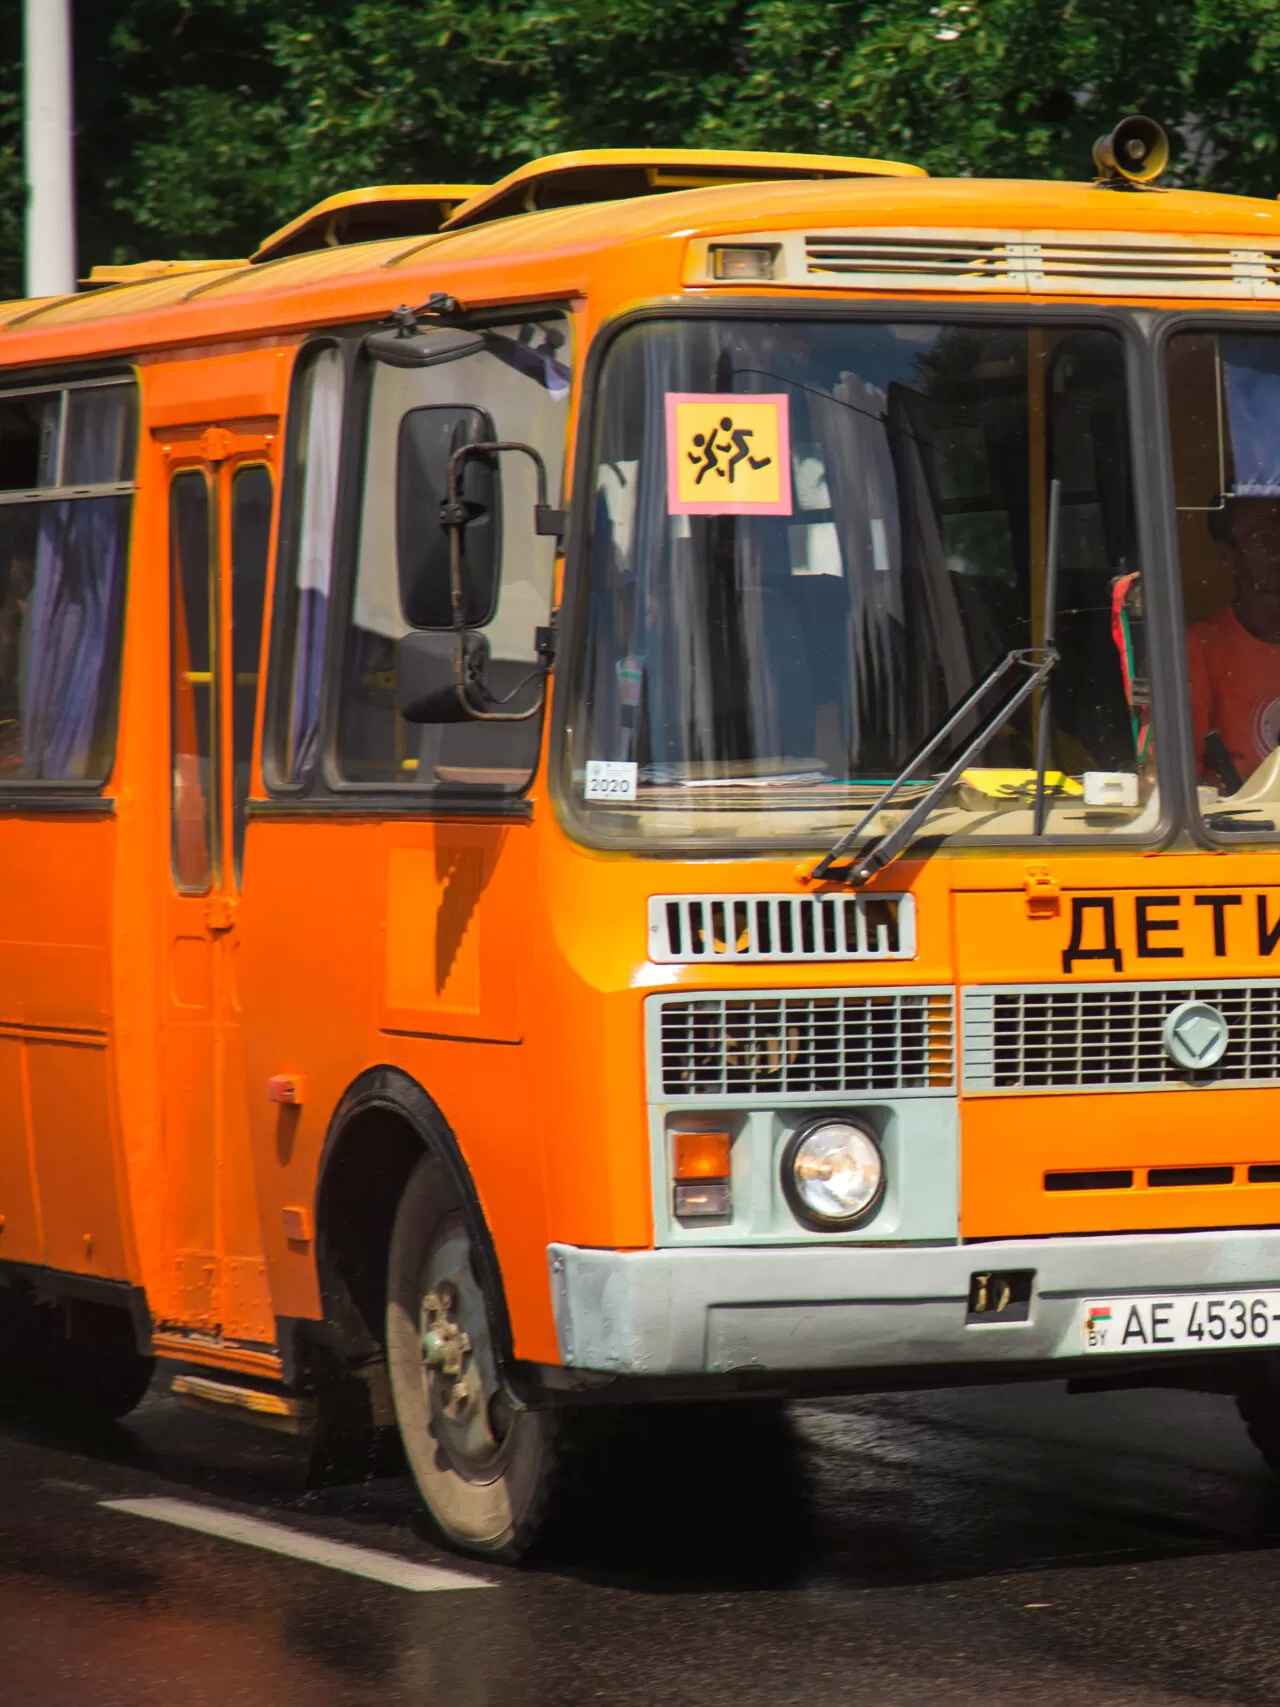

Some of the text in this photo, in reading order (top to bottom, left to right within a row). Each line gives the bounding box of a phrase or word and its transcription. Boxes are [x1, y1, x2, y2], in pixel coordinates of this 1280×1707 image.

[590, 778, 630, 793] 2020
[1121, 1303, 1175, 1346] AE
[1088, 1329, 1108, 1347] BY
